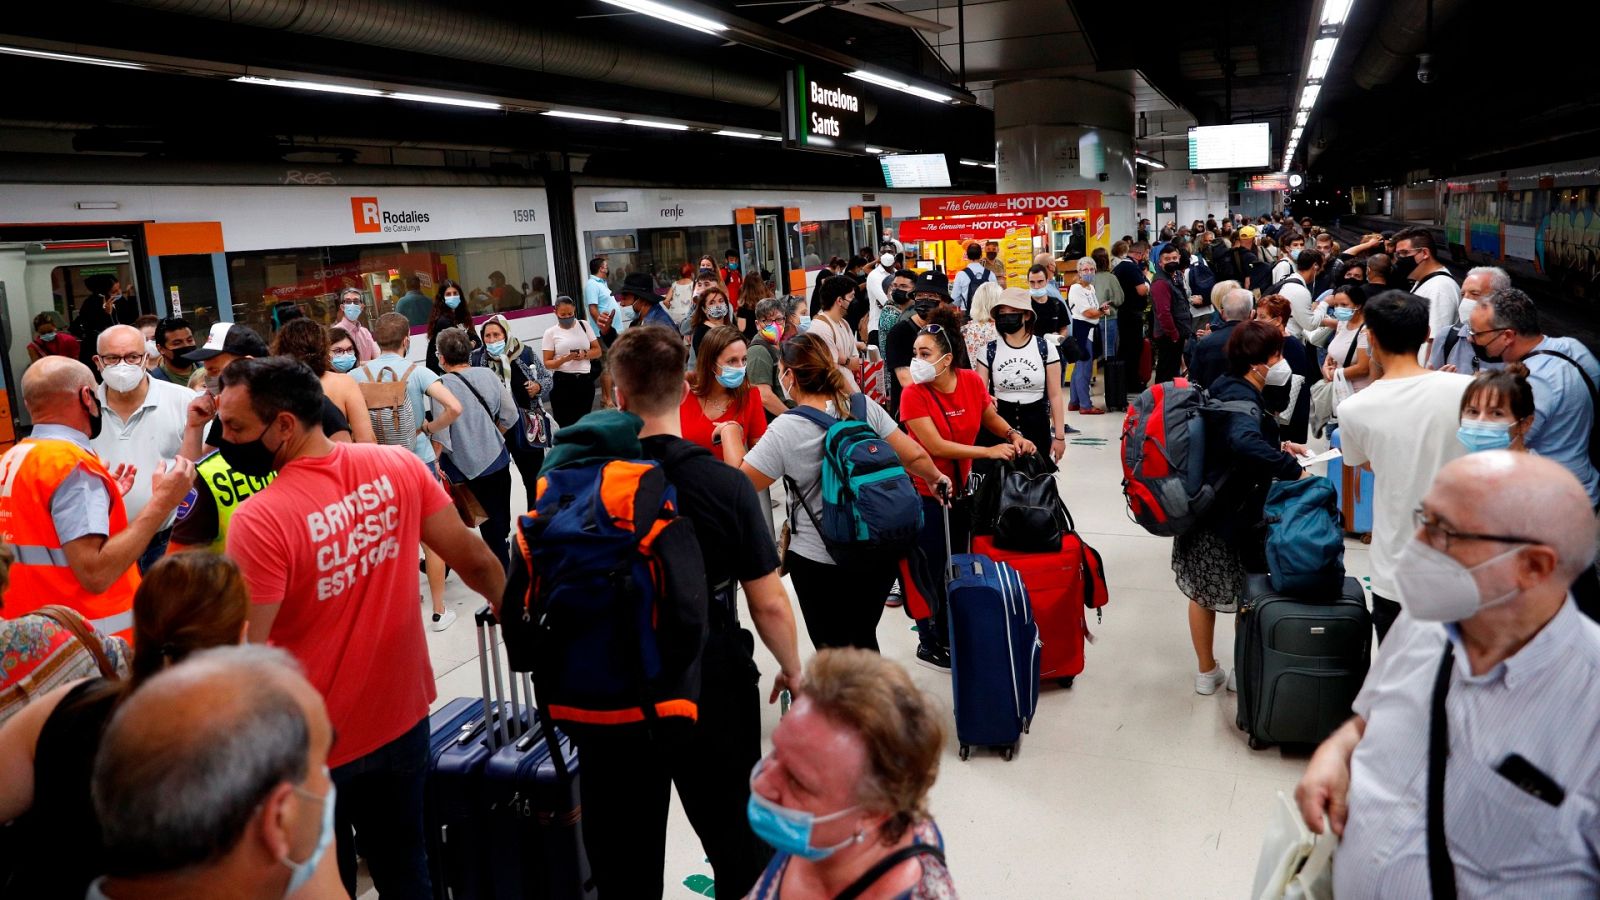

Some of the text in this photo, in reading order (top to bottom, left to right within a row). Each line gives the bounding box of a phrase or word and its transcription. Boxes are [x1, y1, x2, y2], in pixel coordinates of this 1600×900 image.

[810, 80, 859, 113] Barcelona
[811, 112, 840, 137] Sants
[945, 195, 1069, 211] The Genuine HOT DOG
[382, 211, 430, 224] Rodalies
[513, 209, 536, 223] 159R
[660, 203, 684, 221] renfe
[384, 223, 421, 233] de Catalunya
[926, 220, 1018, 231] The Genuine HOT DOG
[997, 357, 1017, 372] GREAT
[306, 474, 395, 543] BRITISH
[316, 505, 399, 572] CLASSIC
